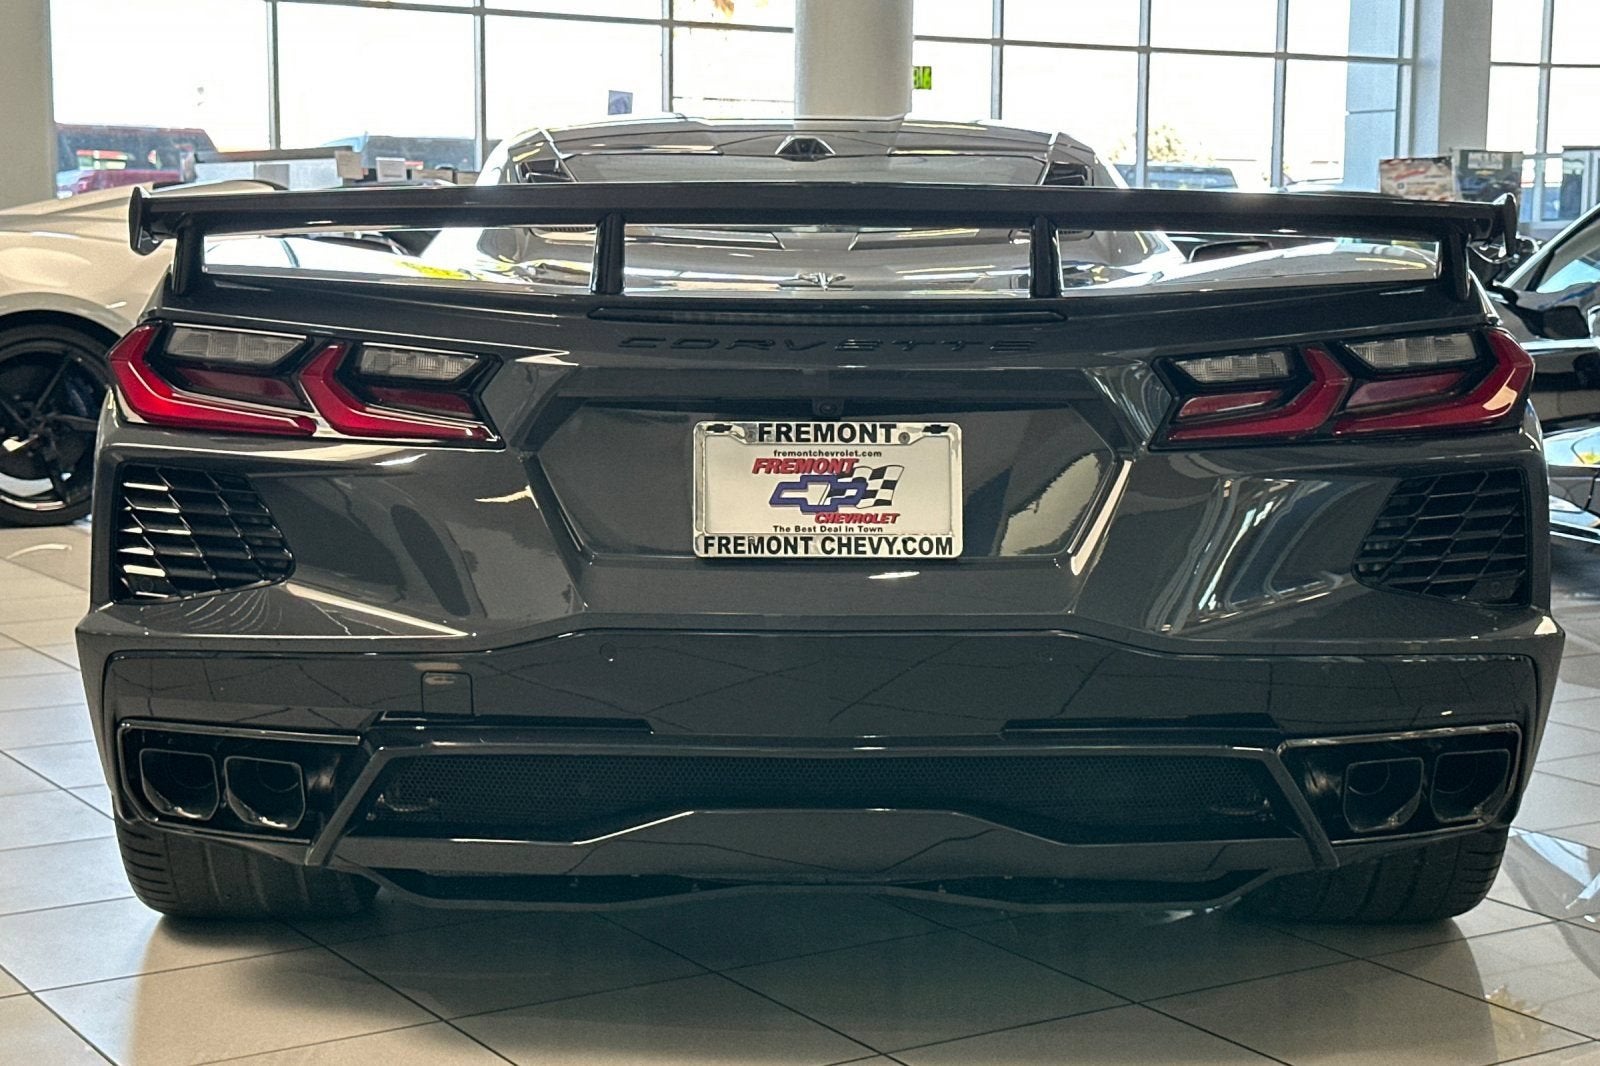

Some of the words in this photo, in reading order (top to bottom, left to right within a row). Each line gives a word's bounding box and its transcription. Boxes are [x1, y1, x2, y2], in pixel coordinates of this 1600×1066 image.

[617, 337, 1037, 352] CORVETTE
[758, 423, 896, 443] FREMONT
[773, 449, 882, 458] fremontchevrolet.com
[752, 458, 859, 474] FREMONT
[814, 512, 900, 524] CHEVROLET
[773, 525, 791, 533] The
[794, 525, 816, 533] Best
[820, 525, 842, 533] Deal
[845, 525, 855, 533] In
[857, 525, 883, 533] Town
[704, 536, 812, 555] FREMONT
[820, 536, 952, 555] CHEVY.COM
